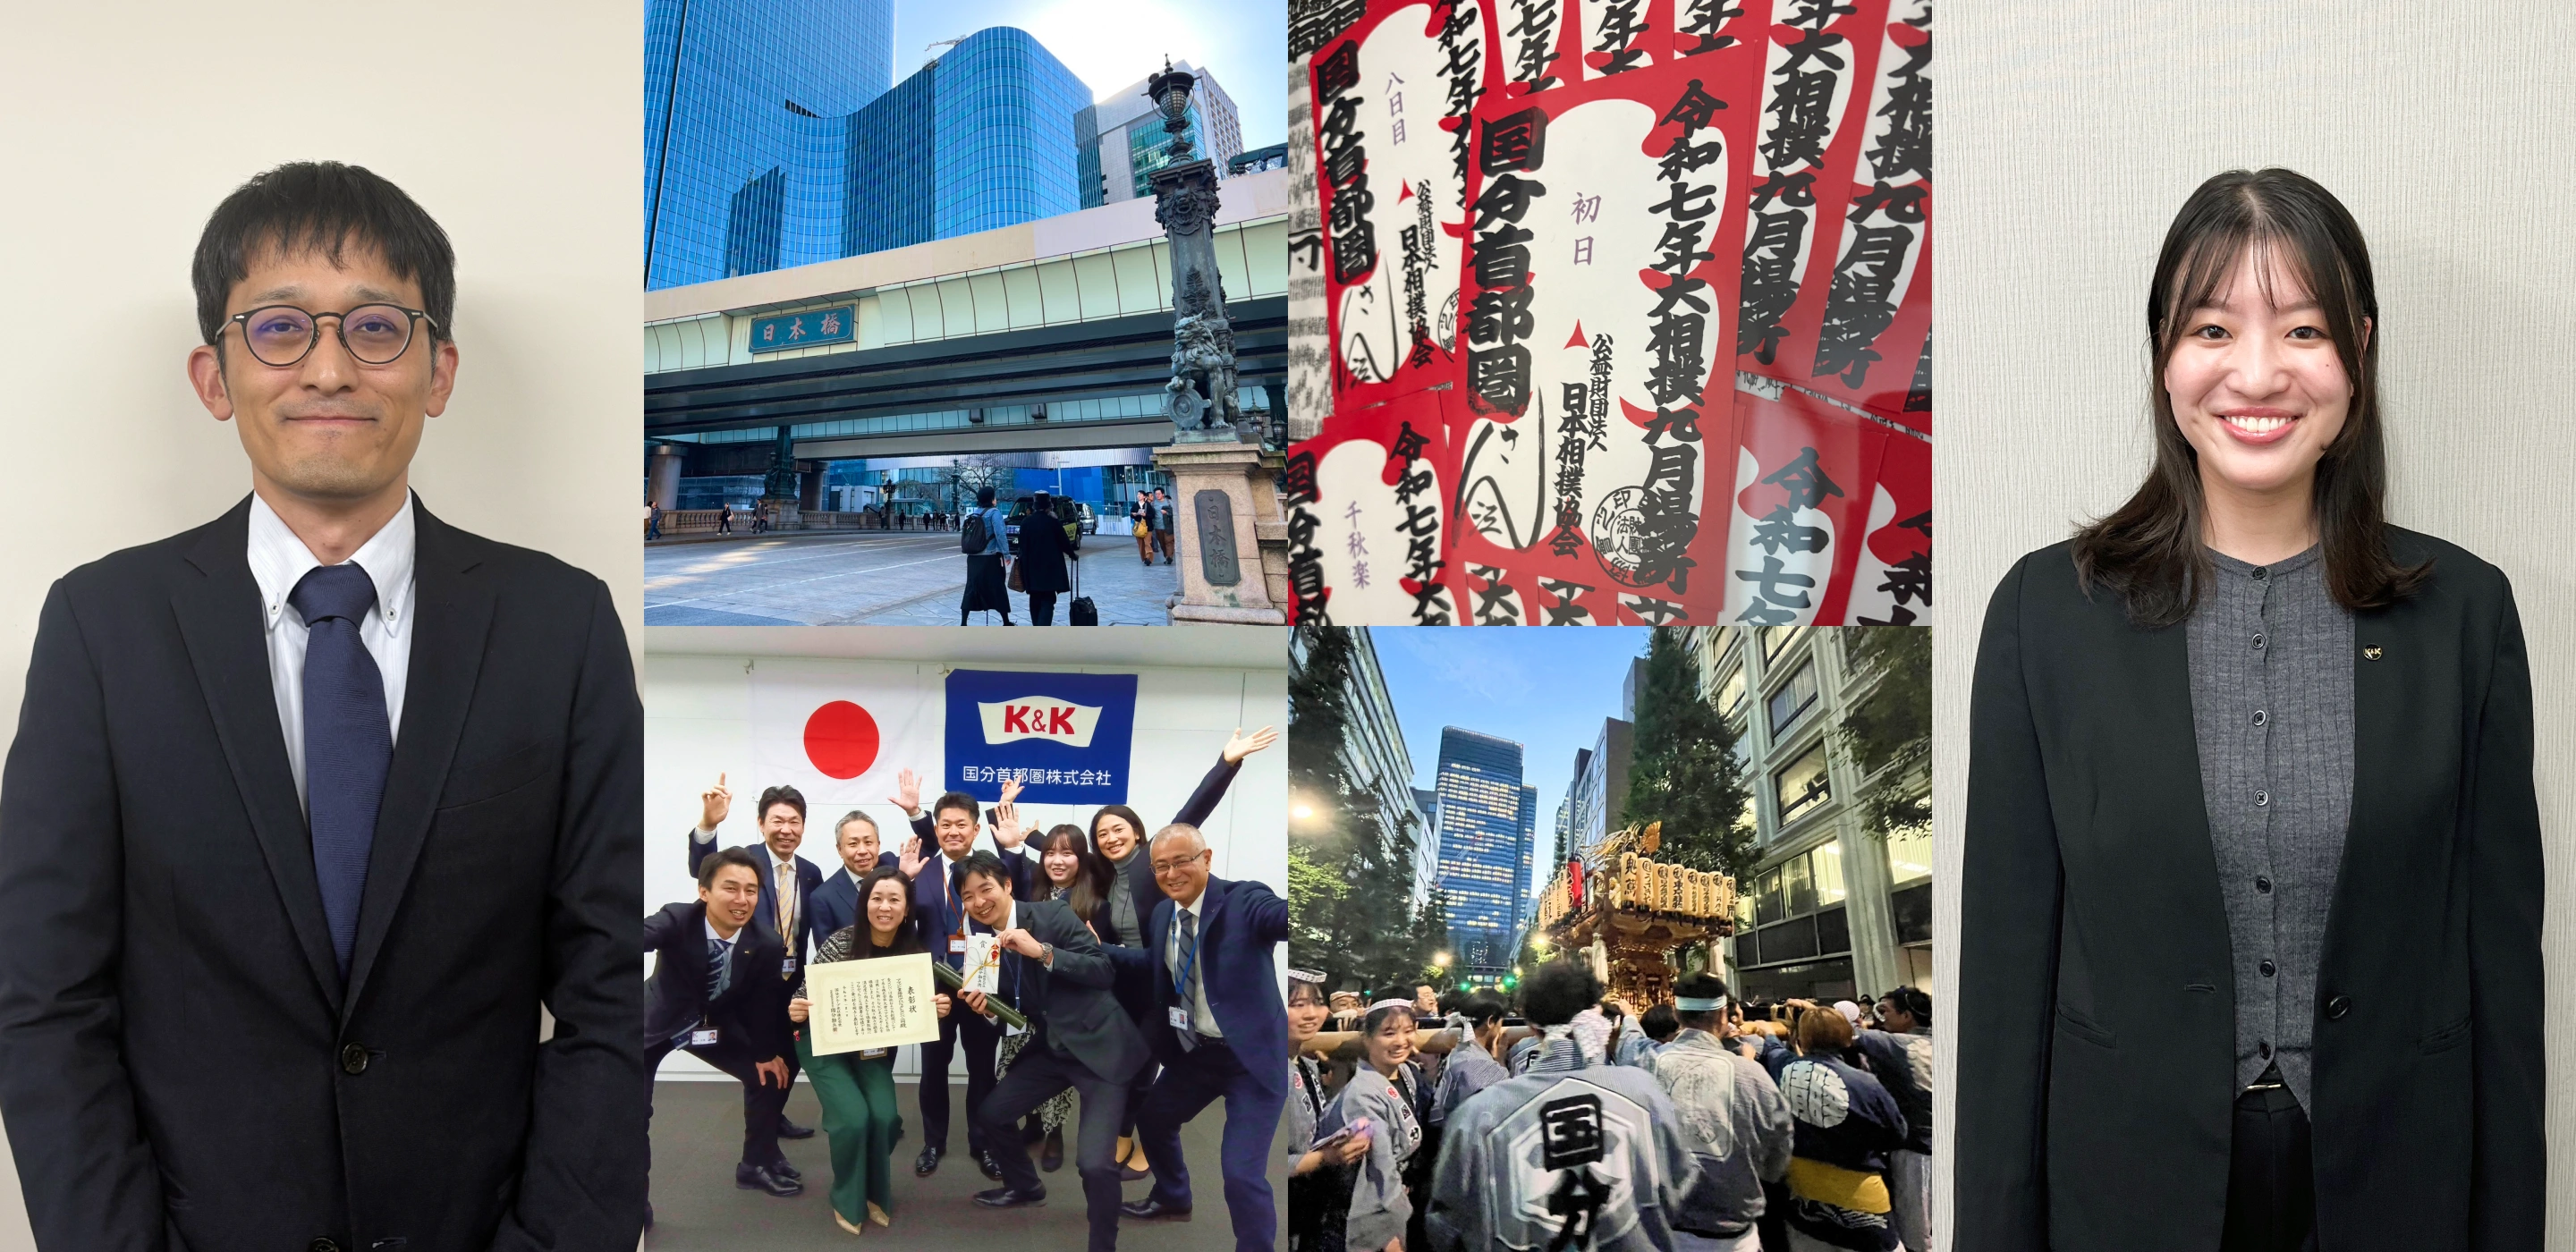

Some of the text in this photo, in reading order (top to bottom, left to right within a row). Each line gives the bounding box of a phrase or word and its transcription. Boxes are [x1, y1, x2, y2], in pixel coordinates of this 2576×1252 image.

[1385, 72, 1406, 146] 八日目
[1316, 39, 1376, 285] 国分首都圏
[1464, 106, 1549, 418] 国分首都圏
[1571, 191, 1602, 266] 初日
[762, 313, 841, 342] 日本橋
[1399, 224, 1436, 369] 日本相撲協会
[1643, 79, 1730, 595] 令和七年大相撲九月場所
[1587, 333, 1614, 453] 公益財団法人
[1547, 381, 1589, 561] 日本相撲協会
[1208, 504, 1231, 568] 日本橋
[1344, 500, 1371, 591] 千秋楽
[1004, 705, 1076, 735] K&K
[963, 766, 1112, 786] 国分首都圏株式会社
[908, 986, 917, 1013] 表彰状
[1539, 1093, 1608, 1252] 国分
